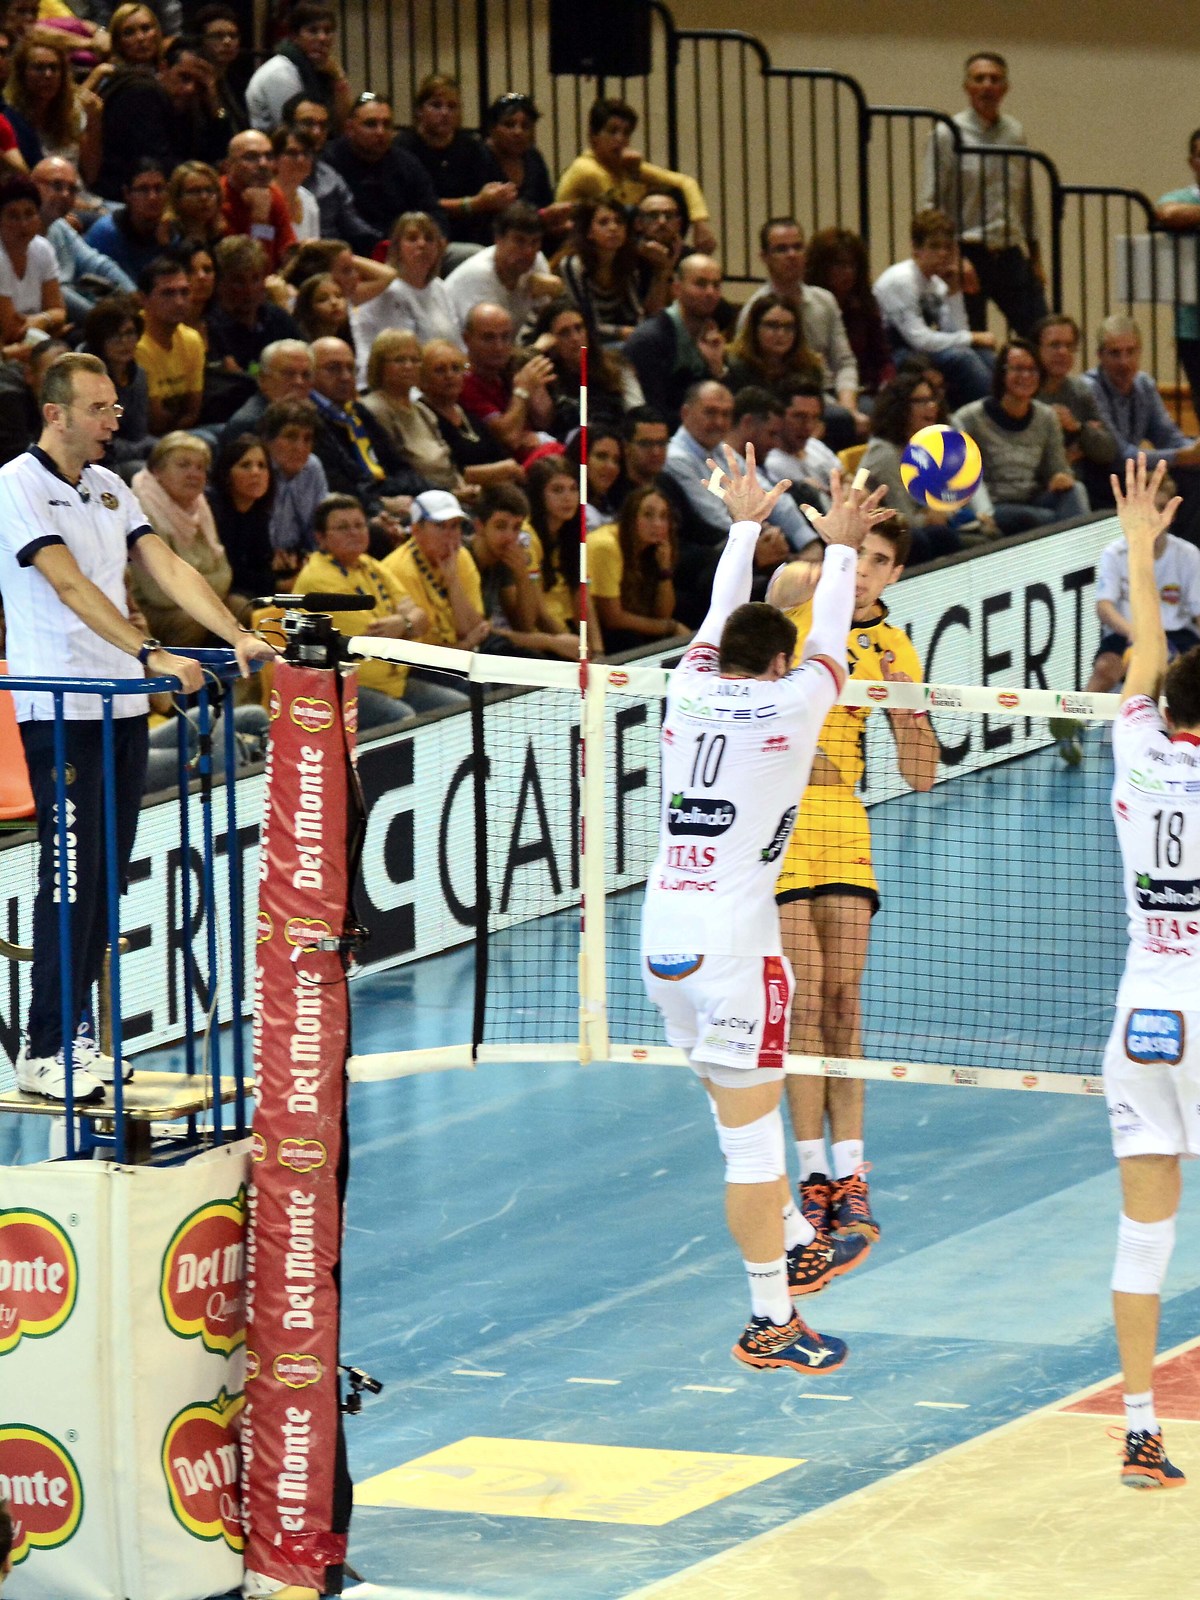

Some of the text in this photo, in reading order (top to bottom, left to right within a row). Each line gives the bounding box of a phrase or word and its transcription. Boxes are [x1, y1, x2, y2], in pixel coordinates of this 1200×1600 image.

[690, 732, 727, 788] 10
[292, 745, 325, 841] Monte
[667, 845, 717, 868] ITAS
[1153, 809, 1184, 869] 18
[292, 842, 324, 891] Del
[1147, 917, 1199, 940] ITAS
[288, 970, 323, 1065] Monte
[287, 1066, 321, 1114] Del
[0, 1256, 65, 1294] onte
[176, 1248, 221, 1294] Del
[282, 1189, 317, 1331] Del Monte
[172, 1449, 223, 1496] Del
[276, 1406, 312, 1502] Monte
[0, 1470, 69, 1508] onte
